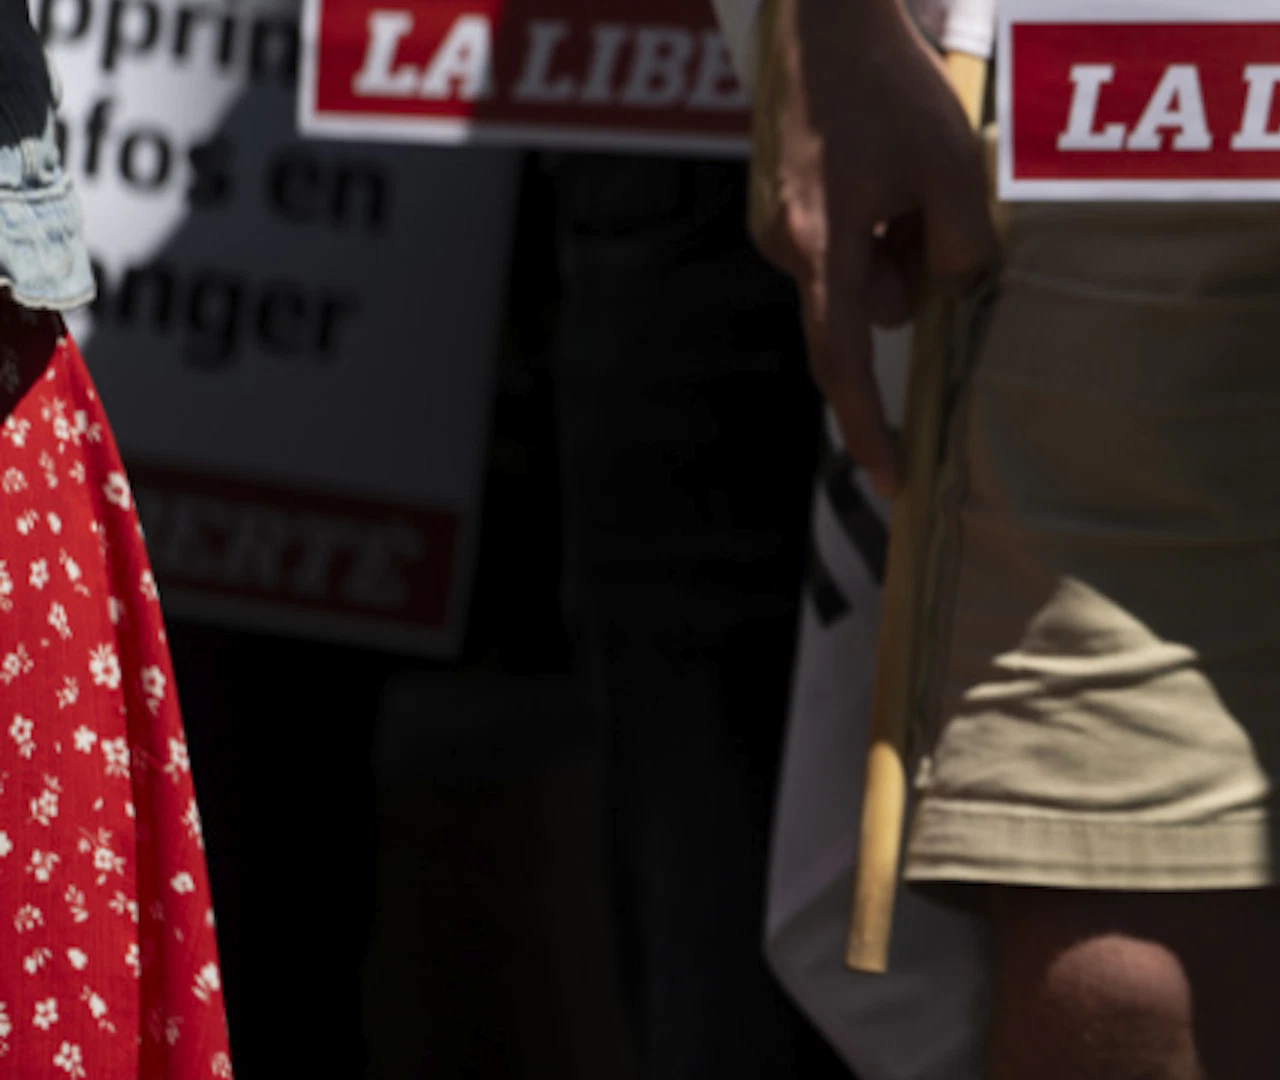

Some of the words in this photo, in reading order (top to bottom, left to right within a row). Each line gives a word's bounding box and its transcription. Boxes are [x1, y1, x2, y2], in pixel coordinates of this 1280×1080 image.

[353, 9, 490, 100] LA
[1056, 63, 1213, 152] LA
[268, 153, 391, 232] en
[97, 263, 358, 372] nger
